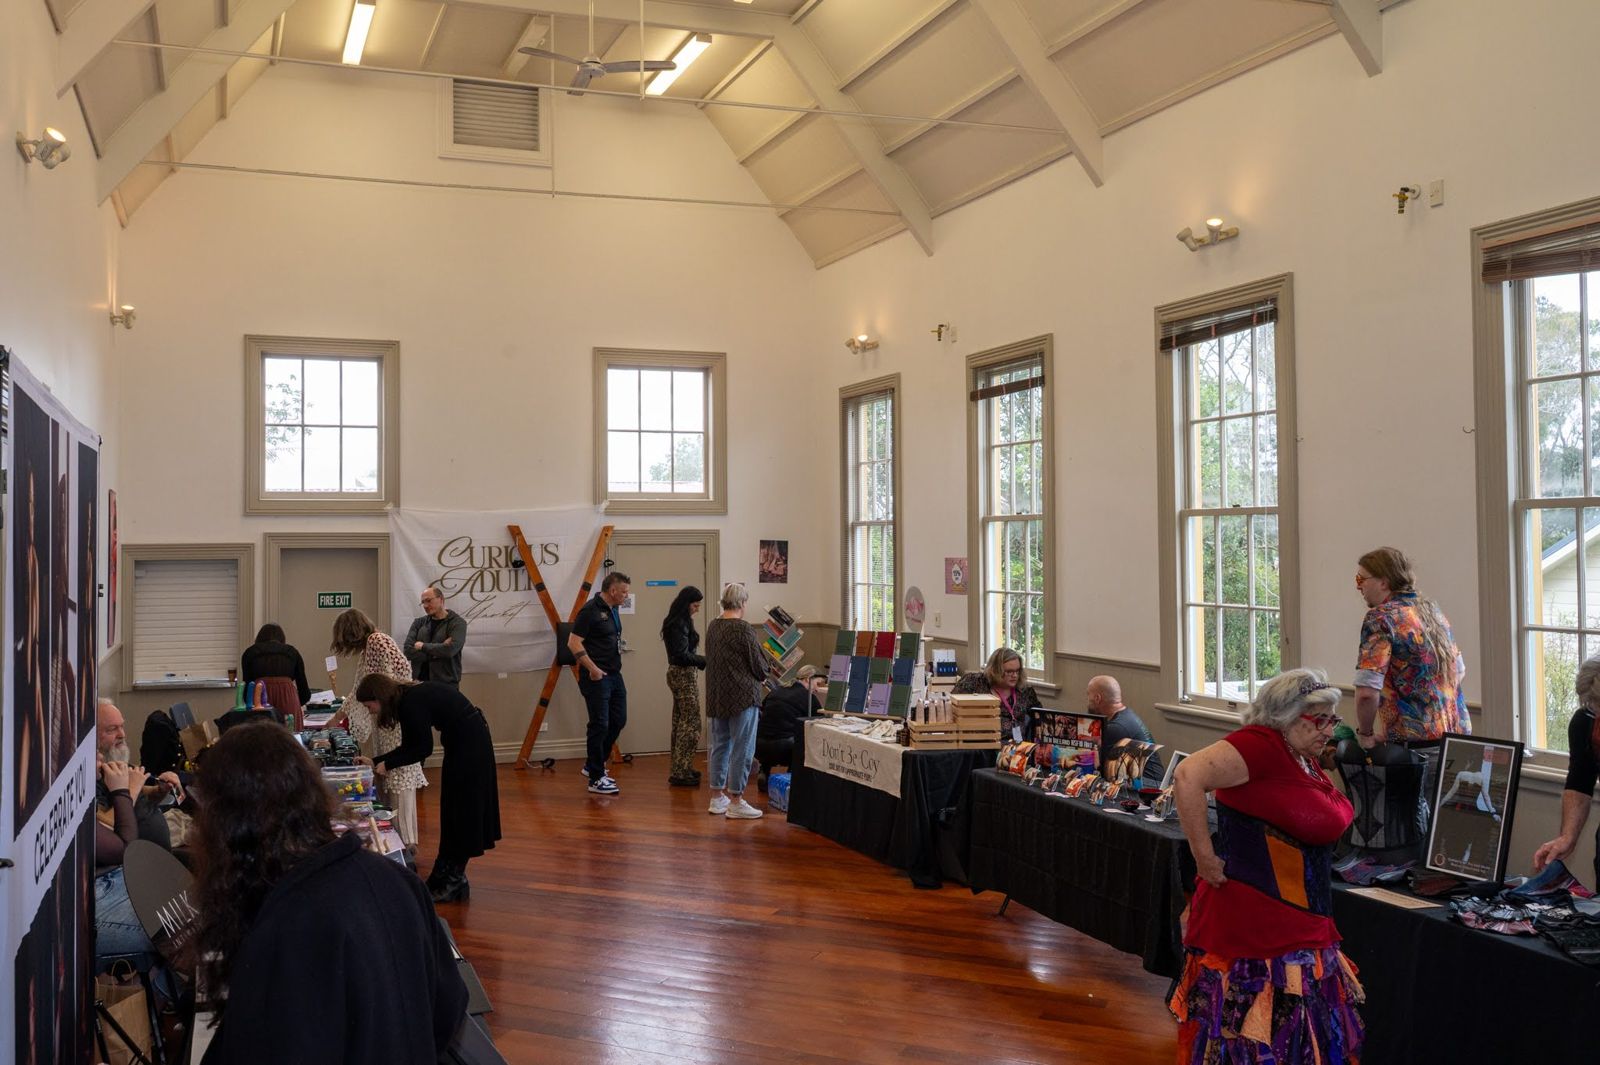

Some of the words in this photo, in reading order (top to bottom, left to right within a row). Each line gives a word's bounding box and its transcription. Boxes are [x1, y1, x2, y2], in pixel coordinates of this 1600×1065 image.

[320, 595, 334, 606] FIRE
[335, 595, 350, 606] EXIT
[822, 738, 845, 763] Don't
[860, 749, 880, 779] Coy
[34, 776, 74, 885] CELEBRATE
[75, 757, 87, 811] YOU
[156, 890, 200, 938] MILK
